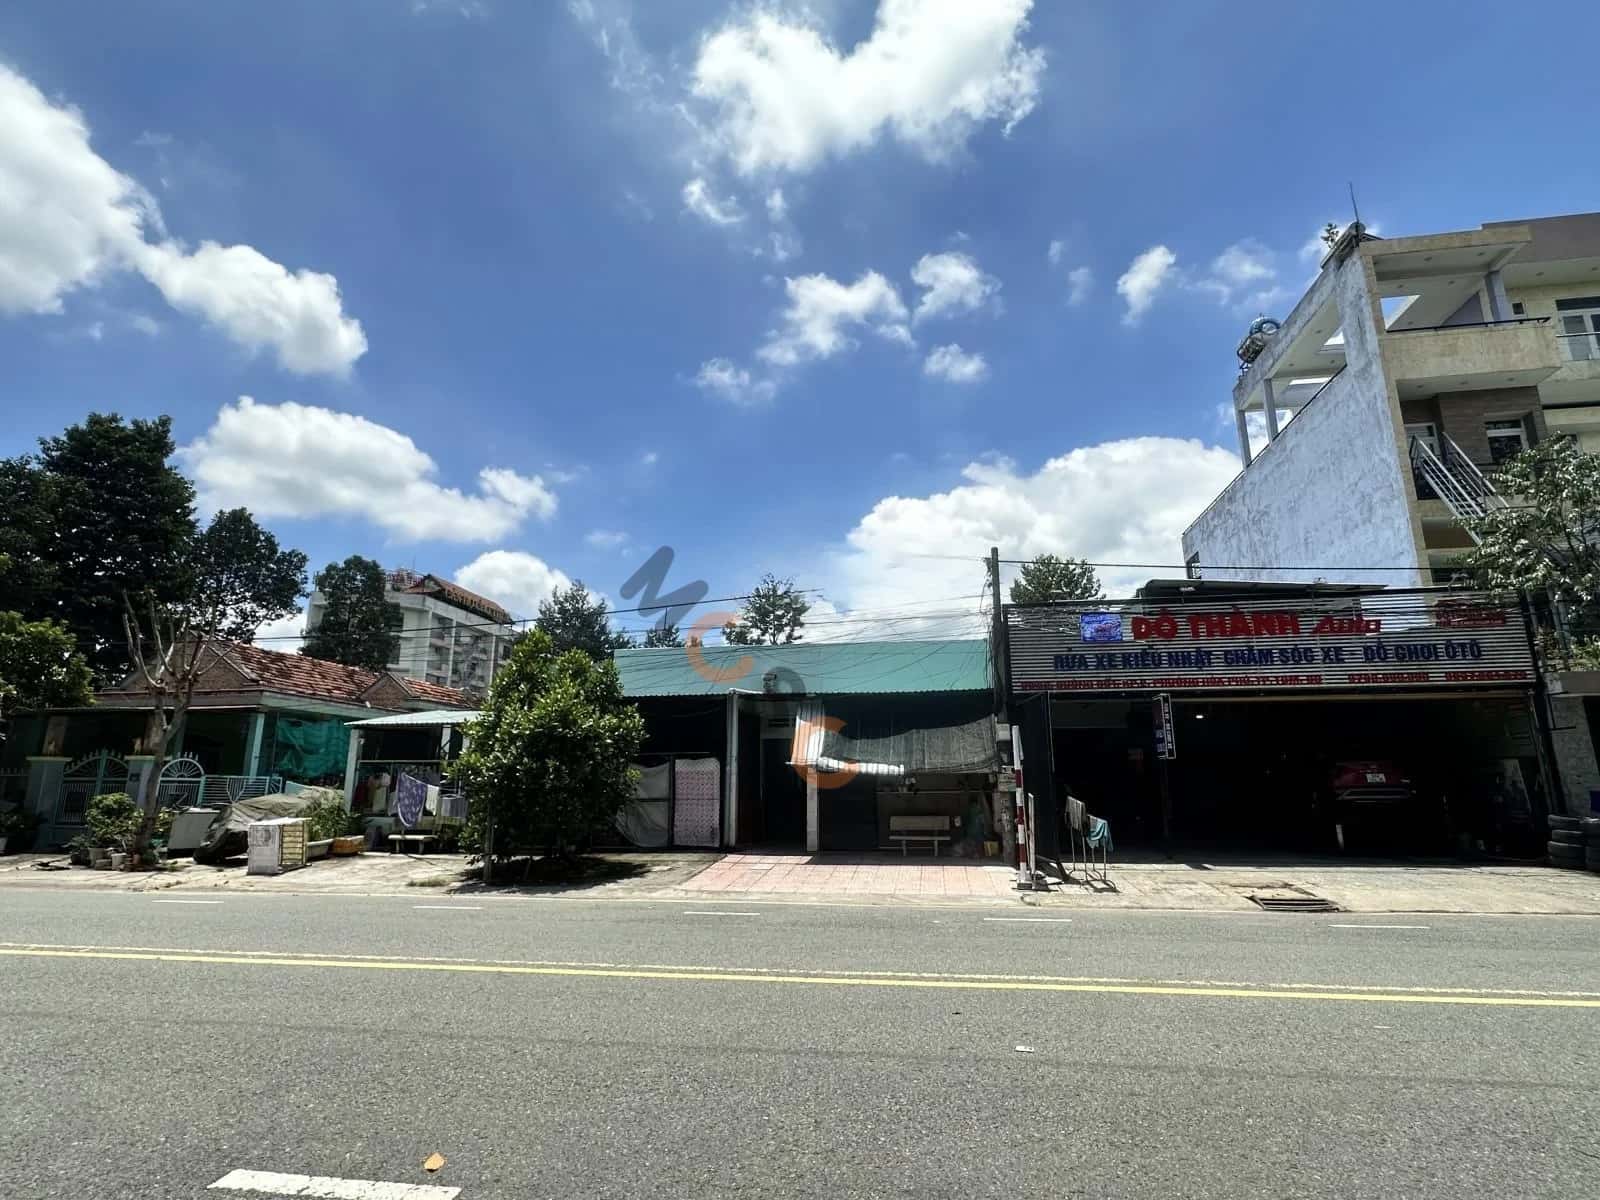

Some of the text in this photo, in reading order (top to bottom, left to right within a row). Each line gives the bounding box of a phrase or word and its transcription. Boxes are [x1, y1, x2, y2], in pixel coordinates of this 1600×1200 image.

[1188, 605, 1301, 639] THÀNH
[1096, 652, 1121, 672] XE
[1321, 645, 1346, 664] XE
